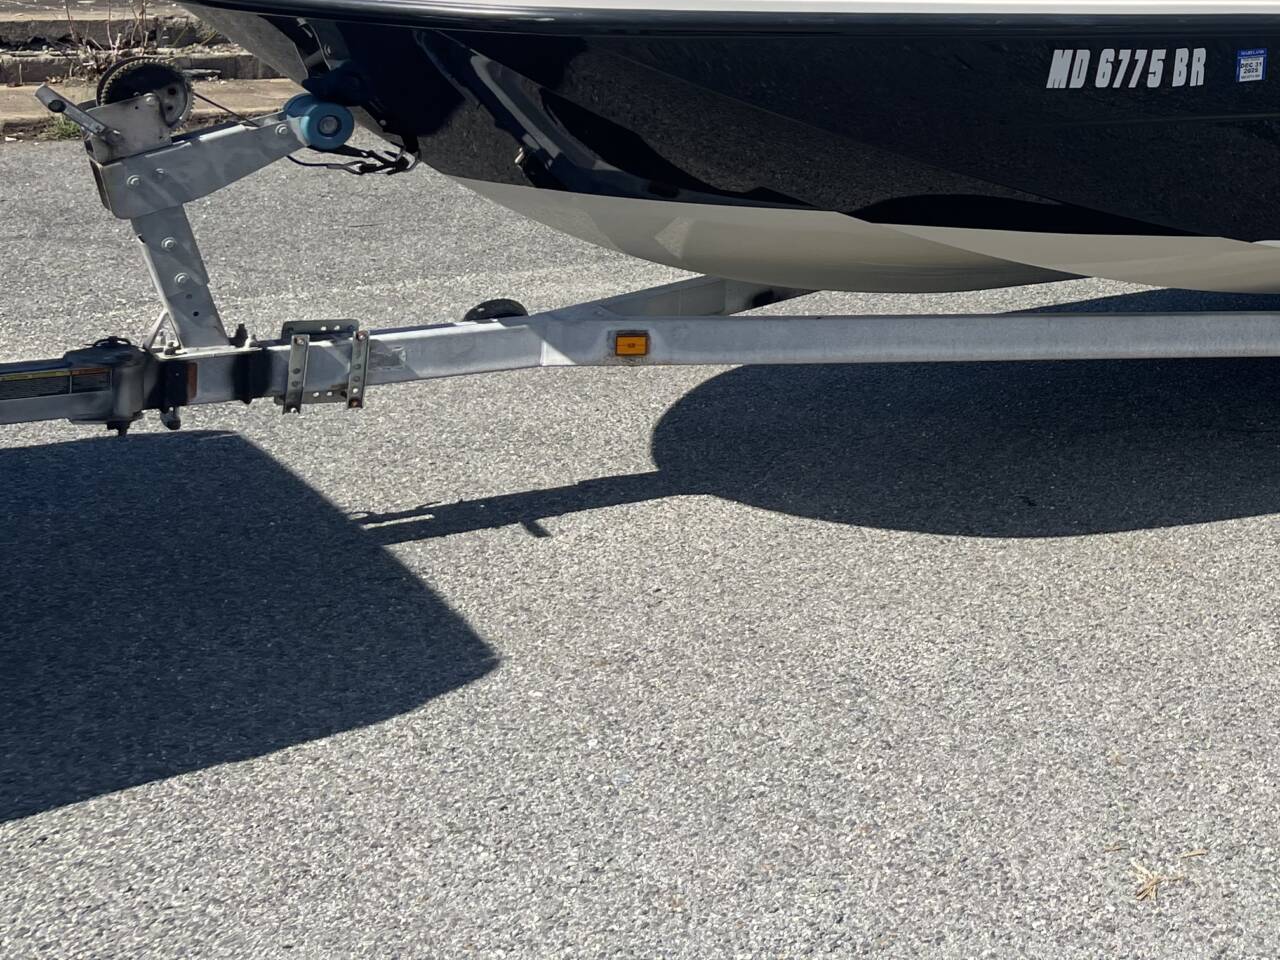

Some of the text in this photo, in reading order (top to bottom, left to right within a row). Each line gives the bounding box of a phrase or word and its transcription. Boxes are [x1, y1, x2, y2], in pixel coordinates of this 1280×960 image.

[1046, 47, 1207, 89] MD 6775 BR
